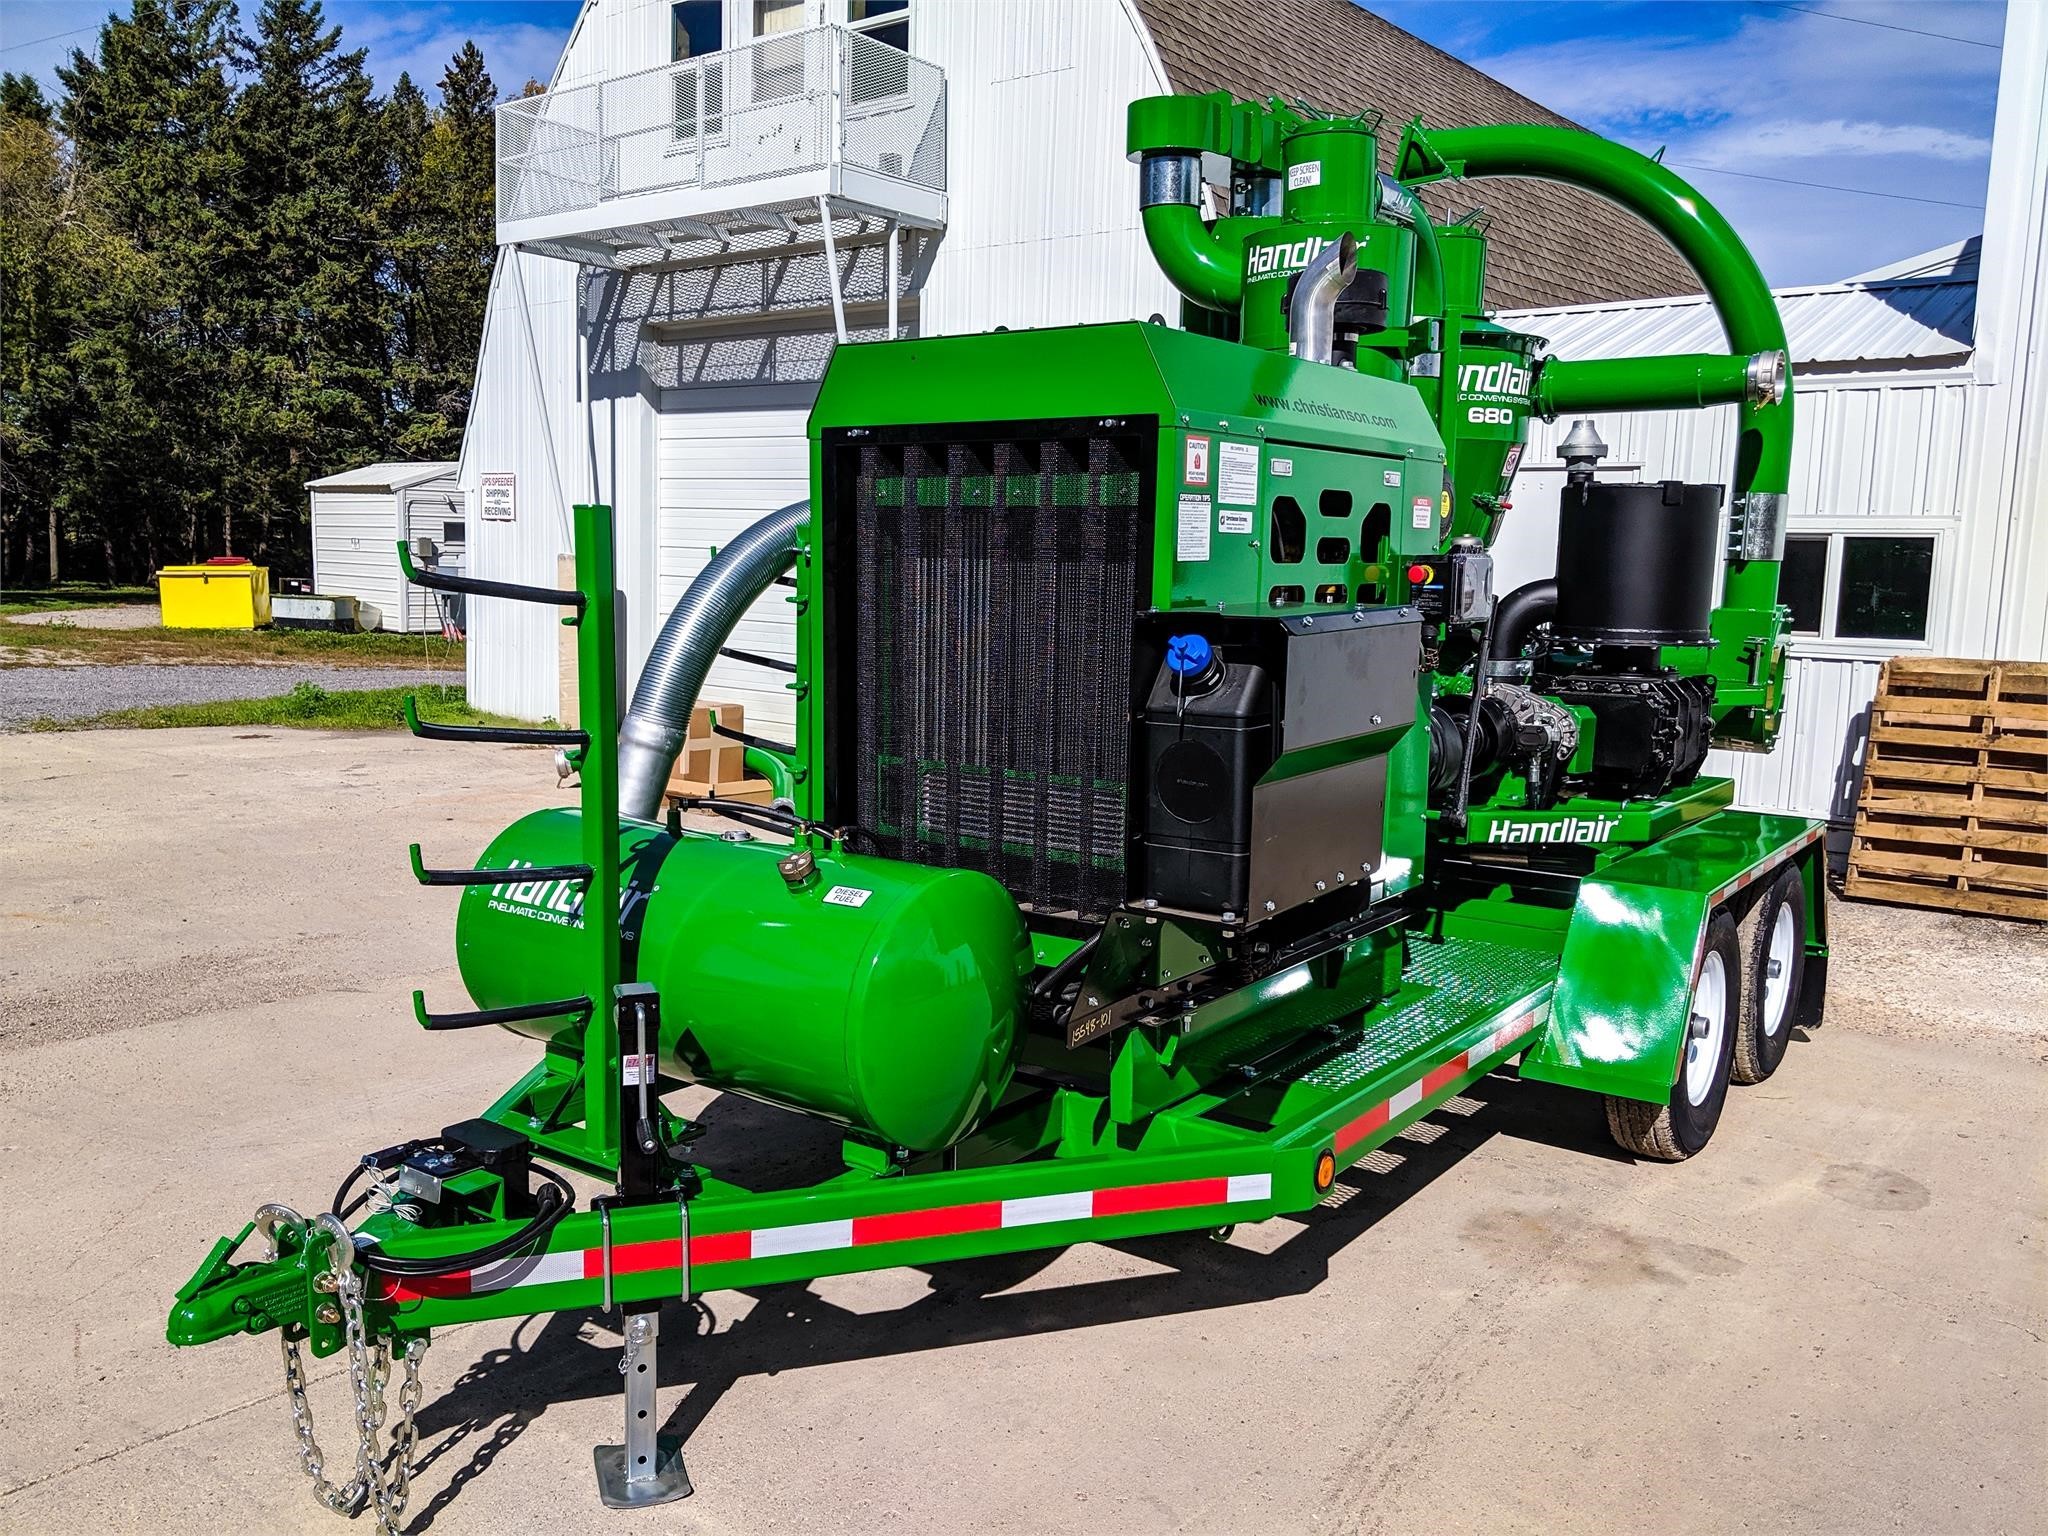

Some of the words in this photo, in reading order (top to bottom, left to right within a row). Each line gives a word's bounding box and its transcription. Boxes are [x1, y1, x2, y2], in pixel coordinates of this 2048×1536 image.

[1299, 163, 1320, 175] SCREEN
[1467, 394, 1513, 404] CONVEYING
[1253, 393, 1397, 430] www.christianson.com
[1468, 406, 1513, 425] 680
[1189, 442, 1207, 450] CAUTION
[486, 488, 510, 498] SHIPPING
[484, 506, 512, 516] RECEIVING
[1488, 814, 1619, 843] Handlair
[834, 888, 864, 898] DIESEL
[833, 895, 855, 903] FUEL
[487, 899, 538, 919] PNEUMATIC
